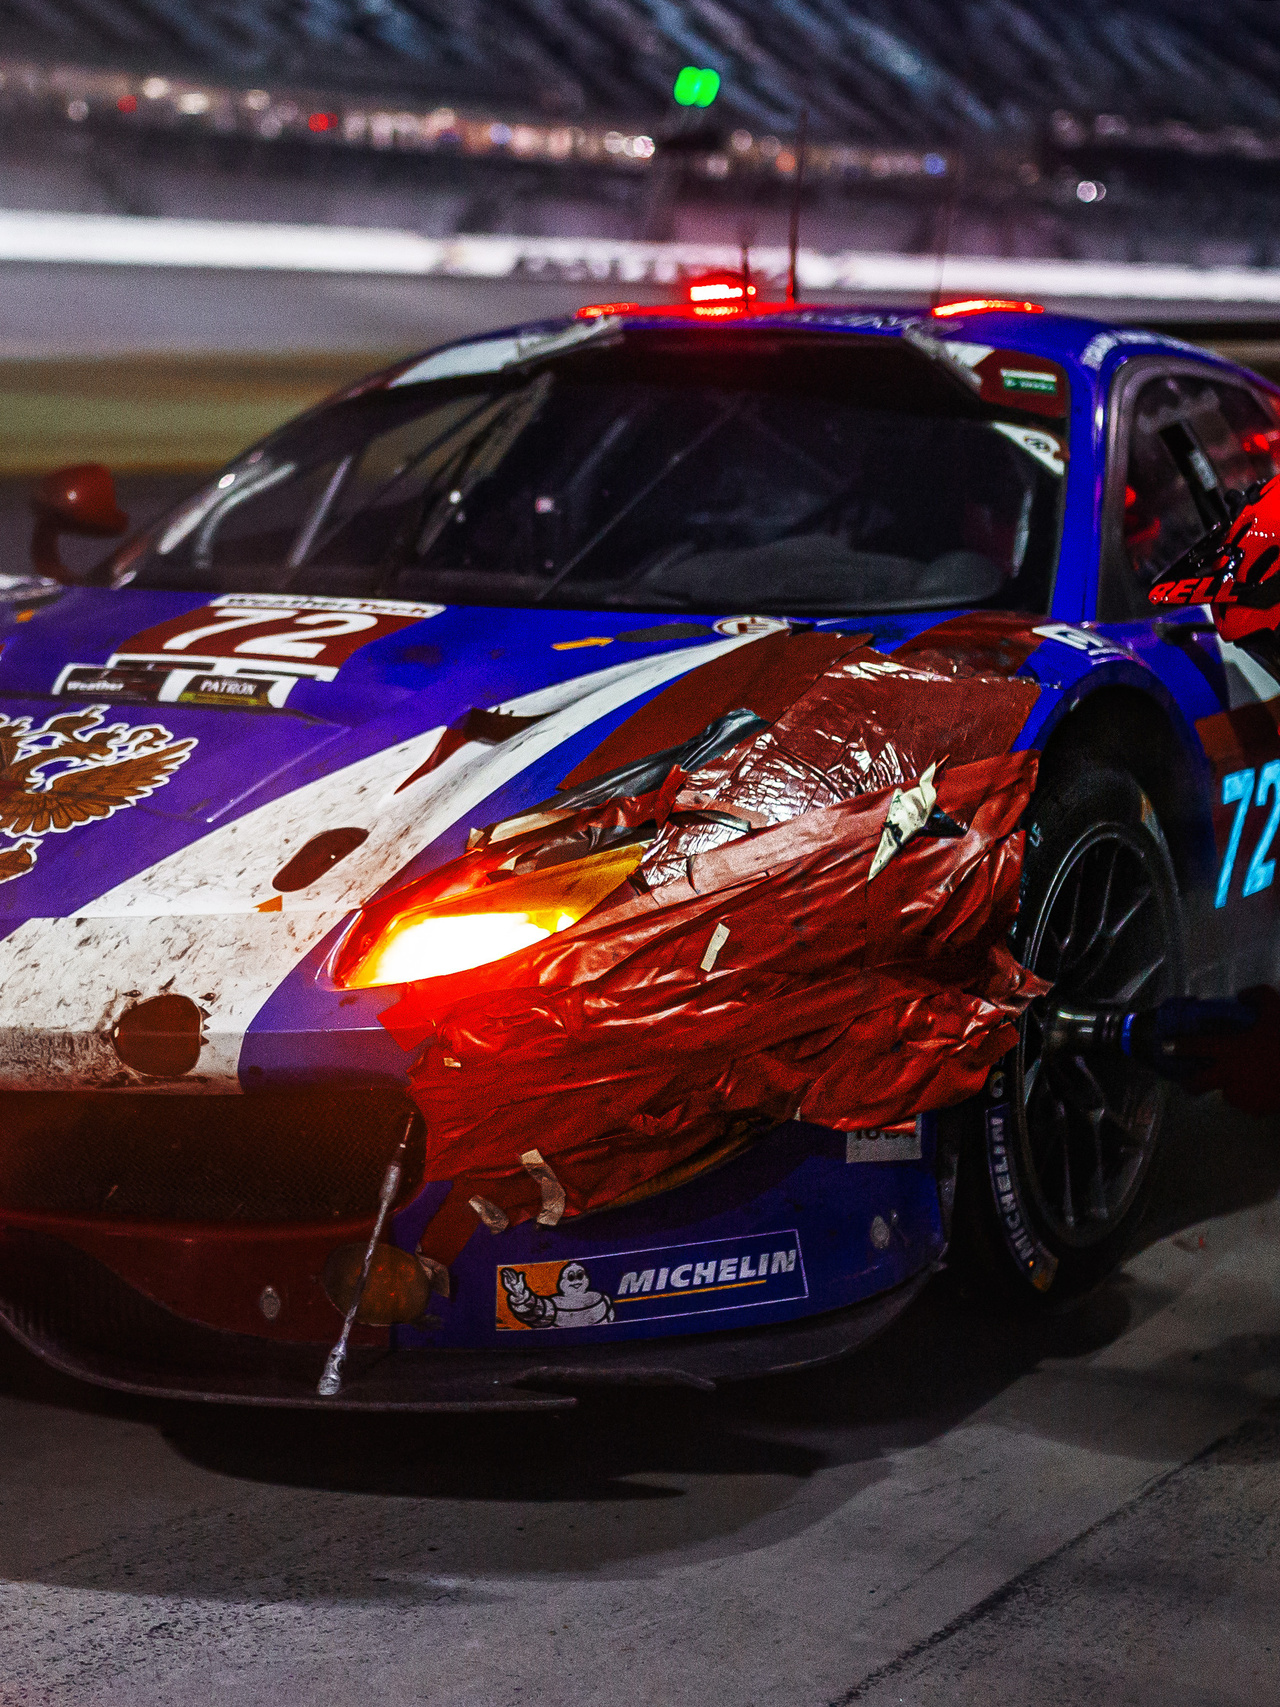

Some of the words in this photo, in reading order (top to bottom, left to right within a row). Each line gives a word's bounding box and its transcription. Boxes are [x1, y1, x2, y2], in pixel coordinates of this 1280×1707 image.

[1148, 577, 1238, 605] BELL
[163, 608, 378, 659] 72
[1214, 759, 1280, 910] 72
[990, 1116, 1034, 1260] MICHELIN
[617, 1249, 797, 1295] MICHELIN
